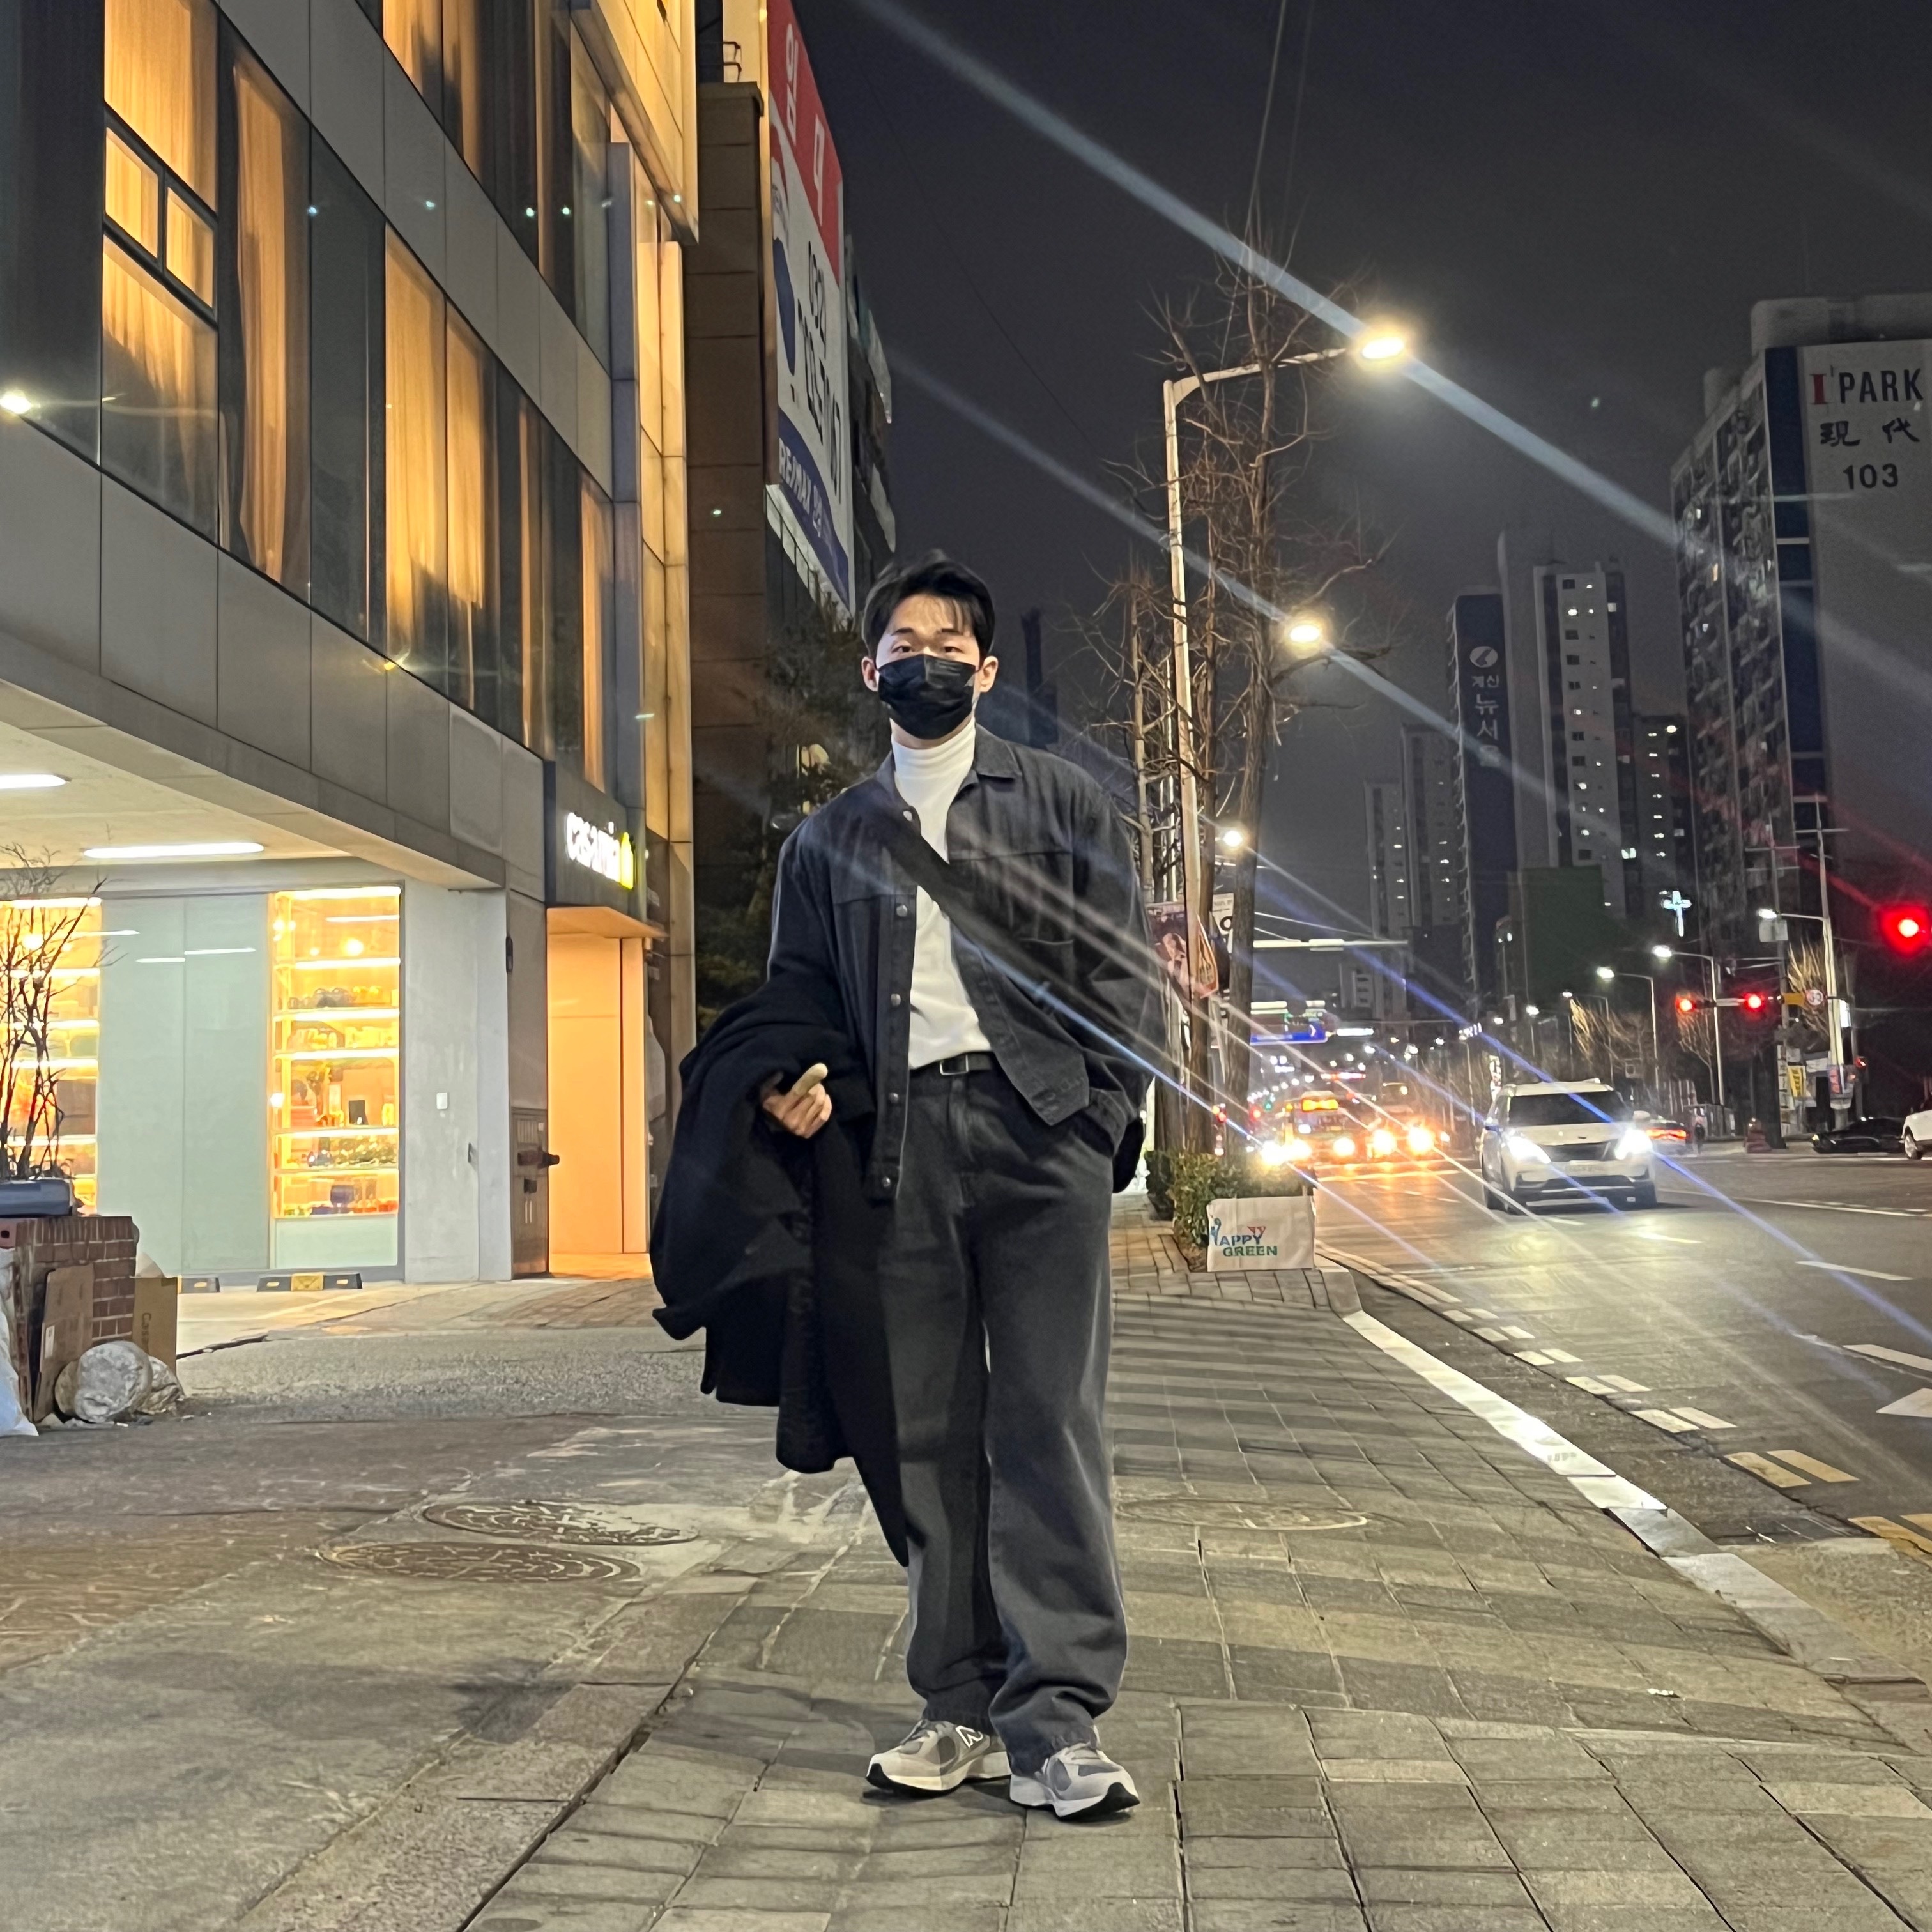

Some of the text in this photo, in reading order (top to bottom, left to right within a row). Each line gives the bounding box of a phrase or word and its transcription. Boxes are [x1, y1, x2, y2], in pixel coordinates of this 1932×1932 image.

[1820, 417, 1920, 447] 現代
[1843, 463, 1899, 490] 103
[1223, 1246, 1277, 1257] GREEN
